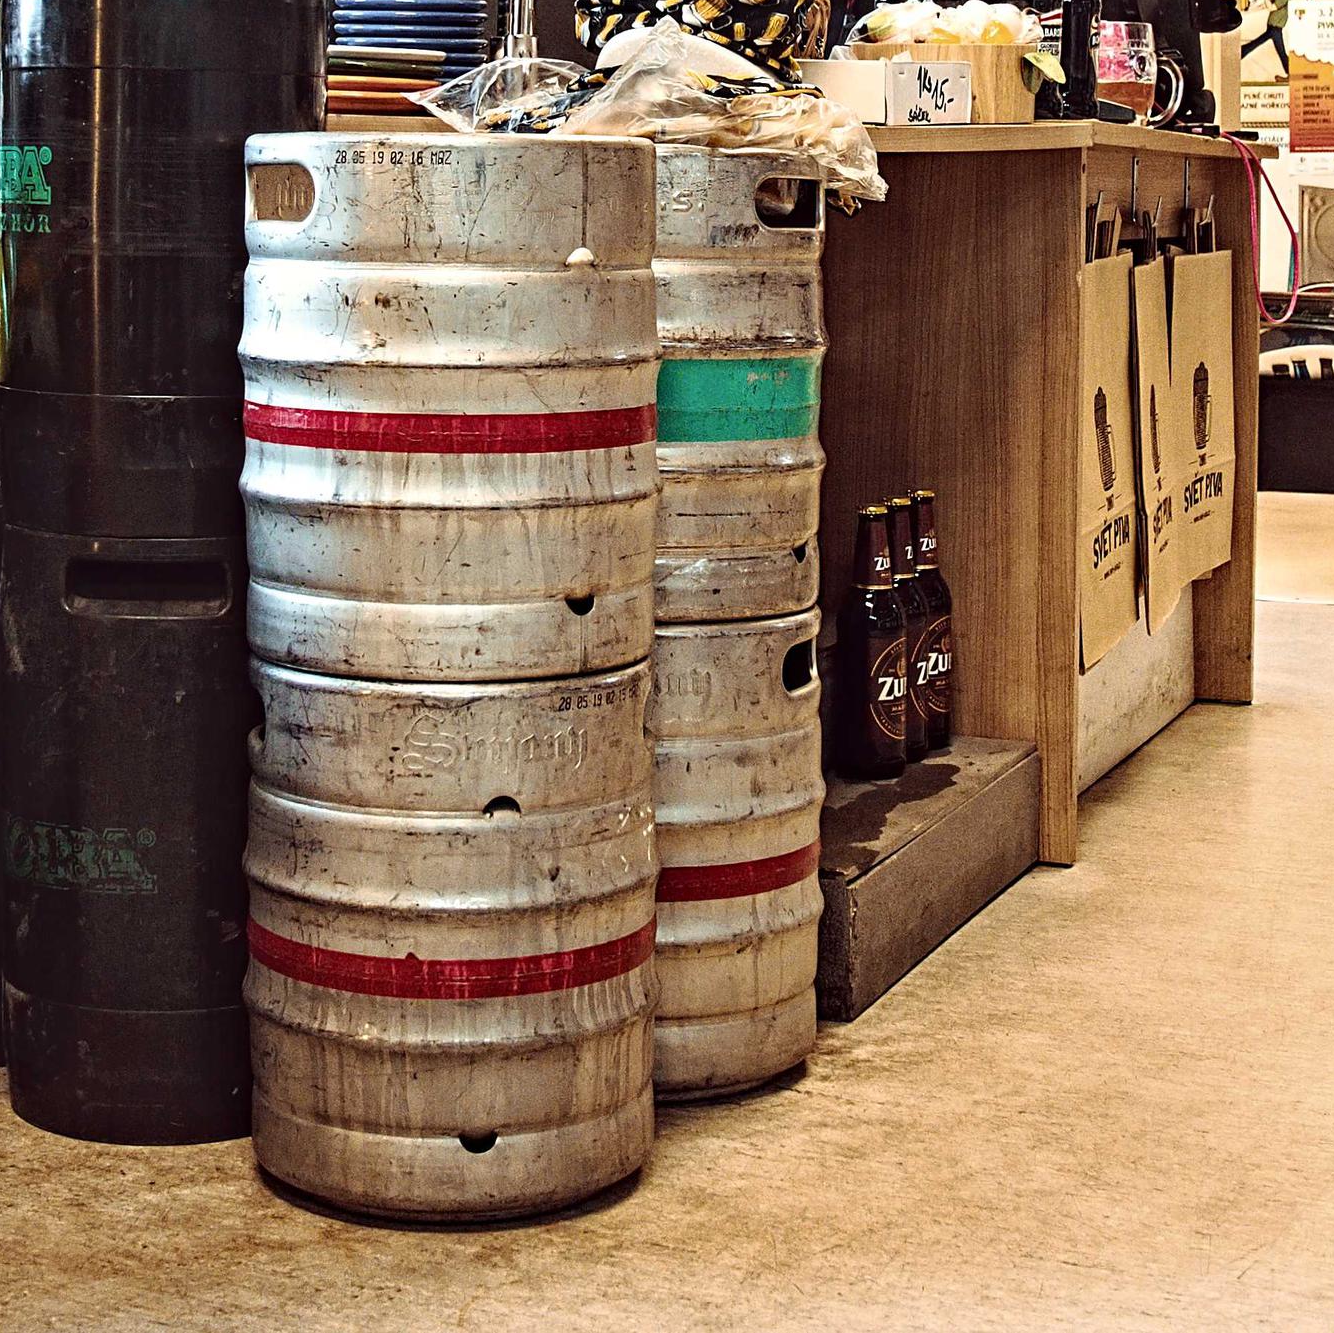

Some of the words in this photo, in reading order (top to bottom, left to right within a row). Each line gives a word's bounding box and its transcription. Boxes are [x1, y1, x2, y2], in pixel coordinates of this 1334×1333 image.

[1183, 471, 1204, 513] SVĚT
[1204, 471, 1223, 500] PIVA
[1093, 516, 1113, 570] SVĚT
[1113, 514, 1130, 549] PIVA
